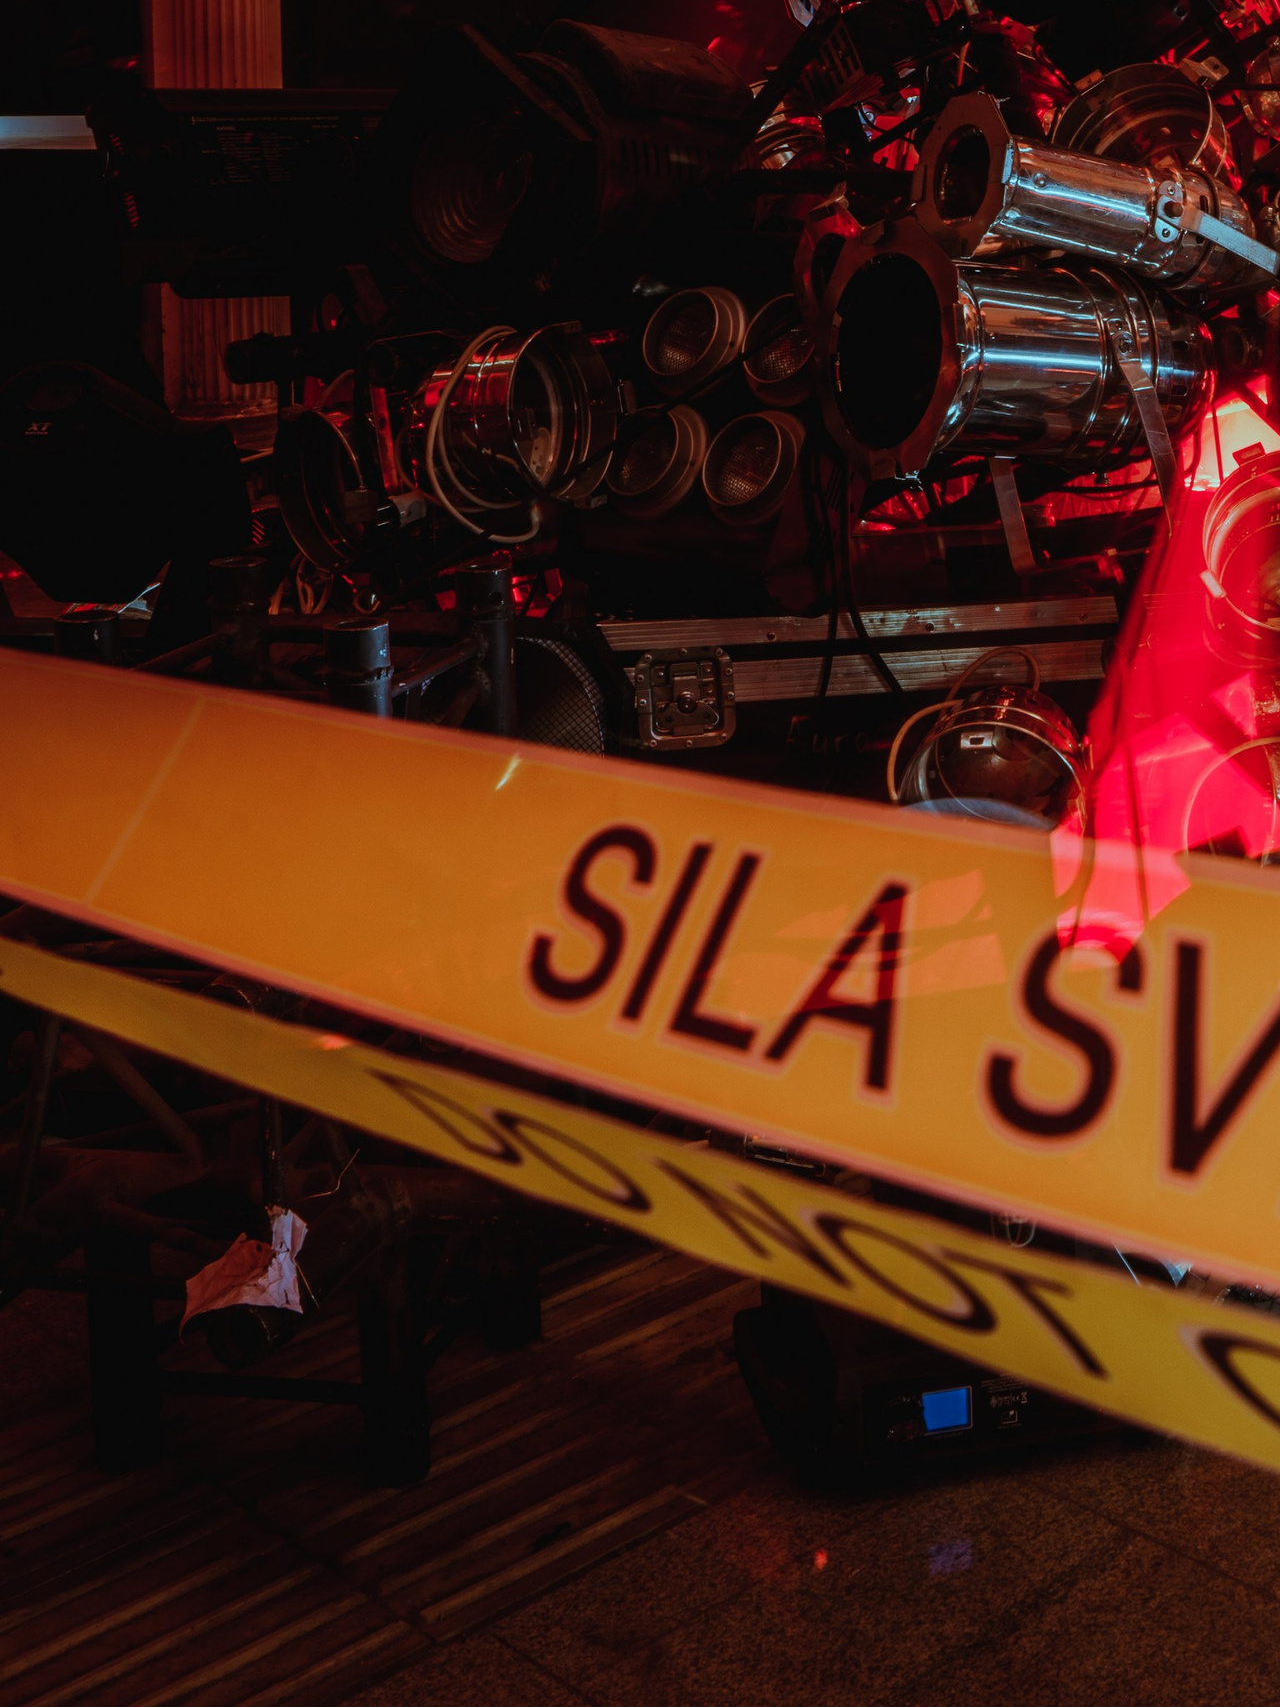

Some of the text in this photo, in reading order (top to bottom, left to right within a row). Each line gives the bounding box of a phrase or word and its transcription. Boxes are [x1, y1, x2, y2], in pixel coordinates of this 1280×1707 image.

[528, 823, 912, 1092] SILA
[366, 1067, 652, 1213] DO
[651, 1155, 1110, 1380] NOT
